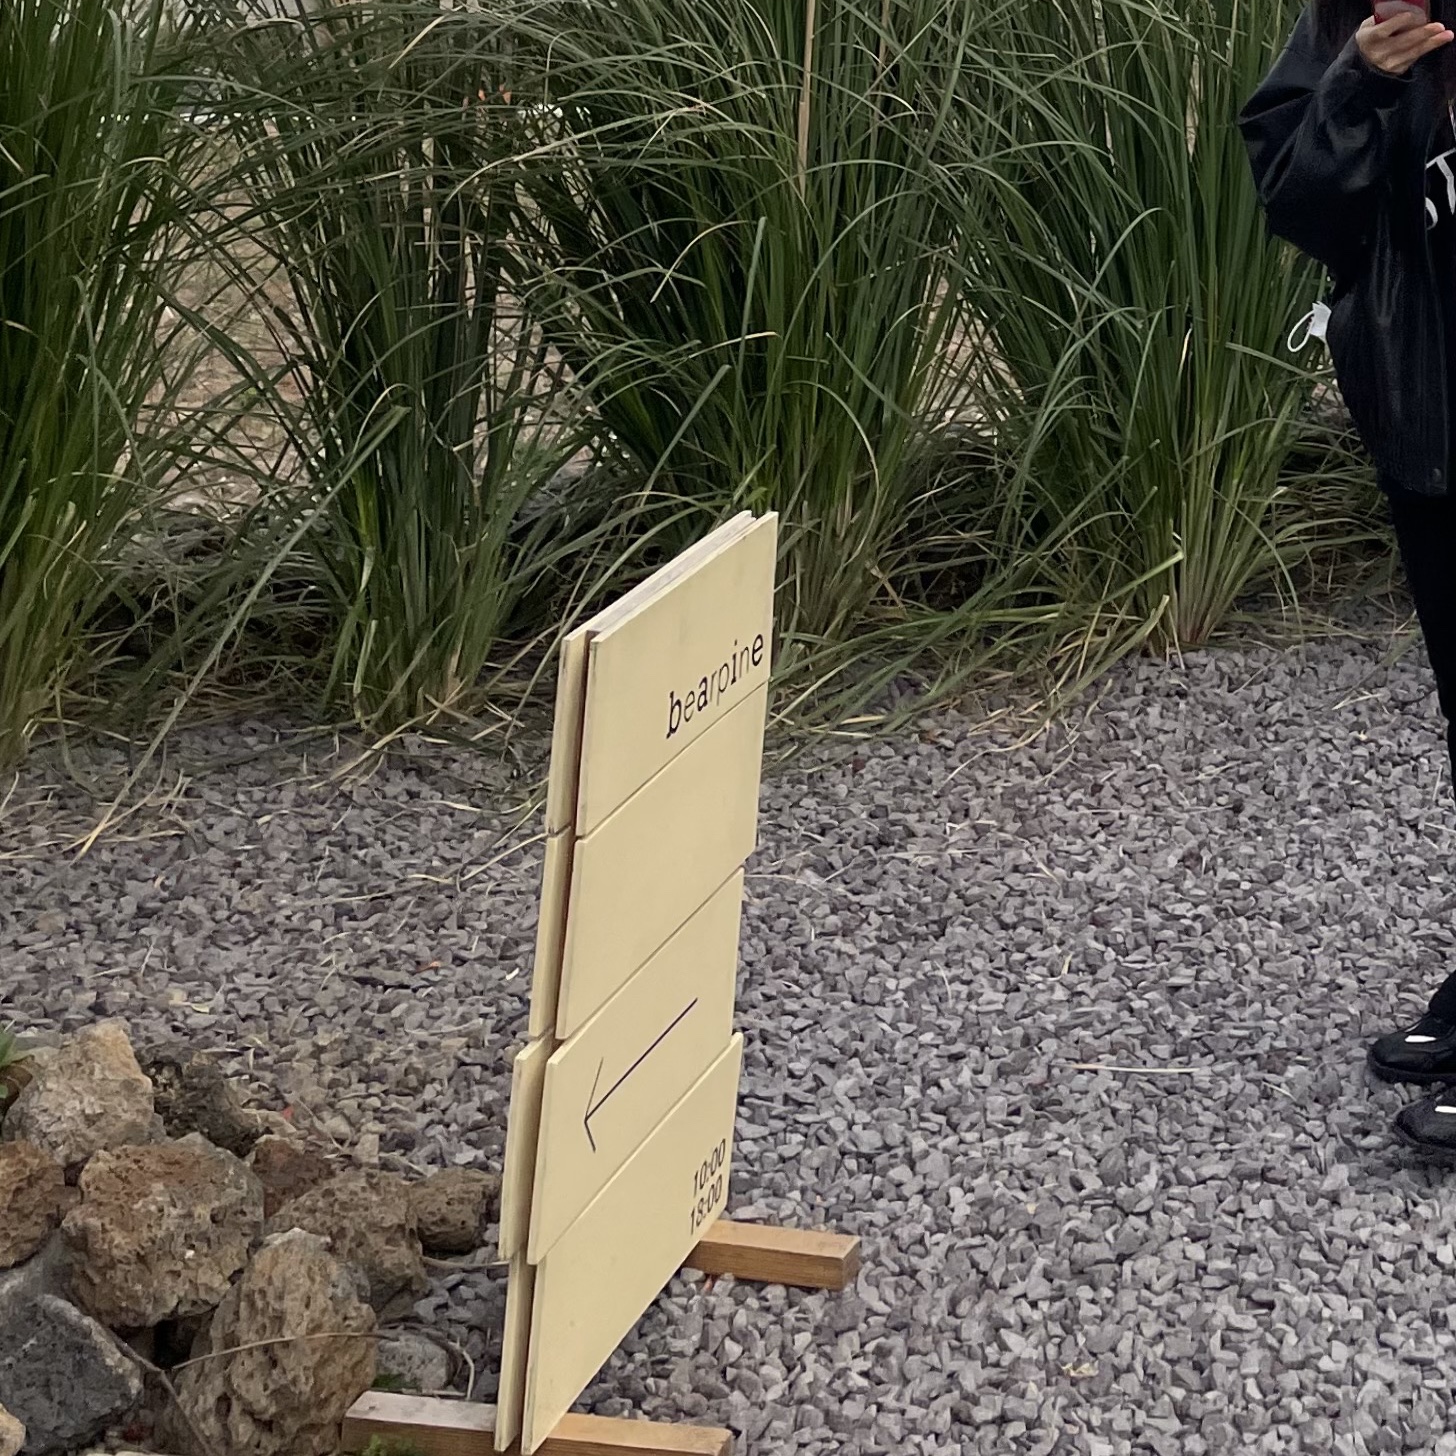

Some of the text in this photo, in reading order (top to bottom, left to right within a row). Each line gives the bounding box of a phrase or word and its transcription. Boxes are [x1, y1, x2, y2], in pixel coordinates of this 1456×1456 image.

[666, 634, 764, 739] bearpine
[694, 1138, 726, 1197] 10:00
[690, 1173, 722, 1235] 18:00
